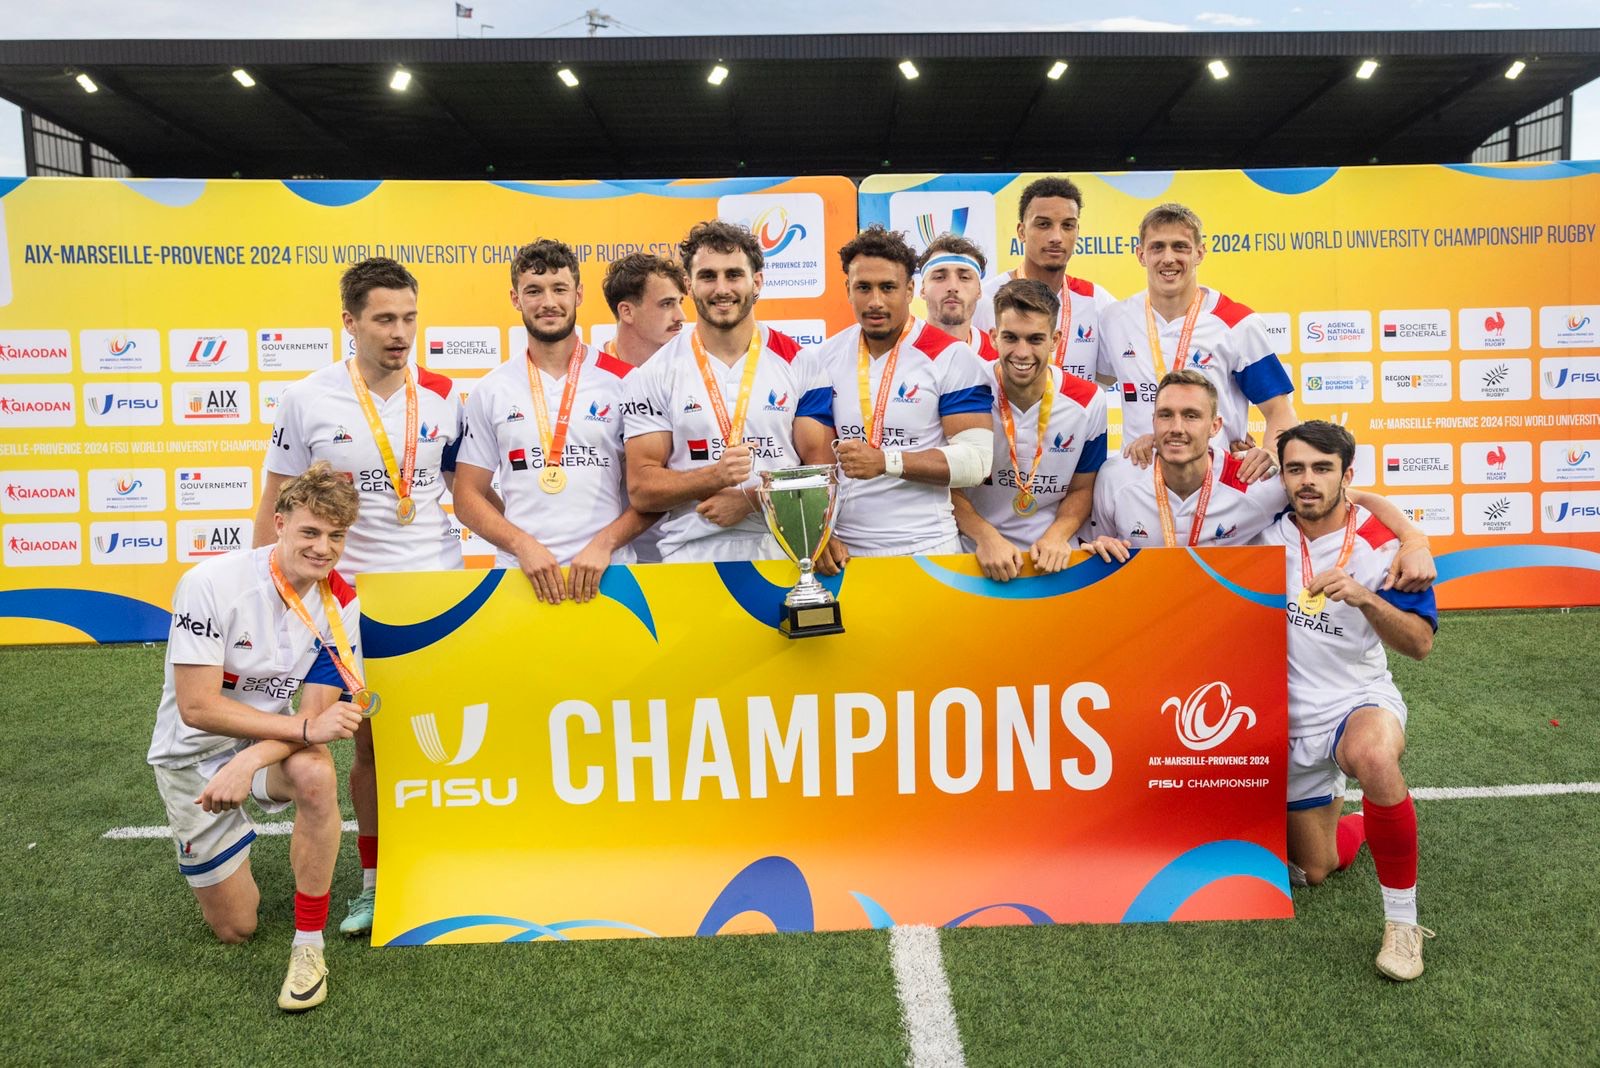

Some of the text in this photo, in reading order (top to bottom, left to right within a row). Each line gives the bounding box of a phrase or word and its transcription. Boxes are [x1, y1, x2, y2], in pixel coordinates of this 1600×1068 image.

[1212, 234, 1251, 252] 2024
[1255, 232, 1286, 251] FISU
[1290, 231, 1342, 250] WORLD
[1346, 228, 1430, 248] UNIVERSITY
[1434, 226, 1543, 247] CHAMPIONSHIP
[1547, 224, 1596, 244] RUGBY
[25, 244, 246, 265] AIX-MARSEILLE-PROVENCE
[251, 245, 292, 265] 2024
[296, 245, 328, 264] FISU
[391, 244, 477, 264] UNIVERSITY
[1399, 323, 1438, 331] SOCIETE
[1399, 330, 1447, 338] GENERALE
[262, 343, 328, 351] GOUVERNEMENT
[446, 340, 487, 348] SOCIETE
[8, 348, 67, 359] QIAODAN
[446, 347, 497, 355] GENERALE
[117, 399, 158, 409] FISU
[207, 390, 237, 408] AIX
[12, 401, 71, 412] QIAODAN
[1369, 416, 1478, 430] AIX-MARSEILLE-PROVENCE
[1481, 416, 1503, 428] 2024
[1505, 415, 1522, 427] FISU
[1524, 415, 1554, 427] WORLD
[85, 442, 108, 454] 2024
[180, 482, 247, 490] GOUVERNEMENT
[18, 488, 75, 499] QIAODAN
[210, 527, 241, 545] AIX
[21, 540, 77, 551] QIAODAN
[122, 538, 163, 547] FISU
[549, 681, 1113, 805] CHAMPIONS
[1148, 756, 1270, 766] AIX-MARSEILLE-PROVENCE 2024
[1148, 778, 1270, 789] FISU CHAMPIONSHIP
[395, 777, 517, 808] FISU
